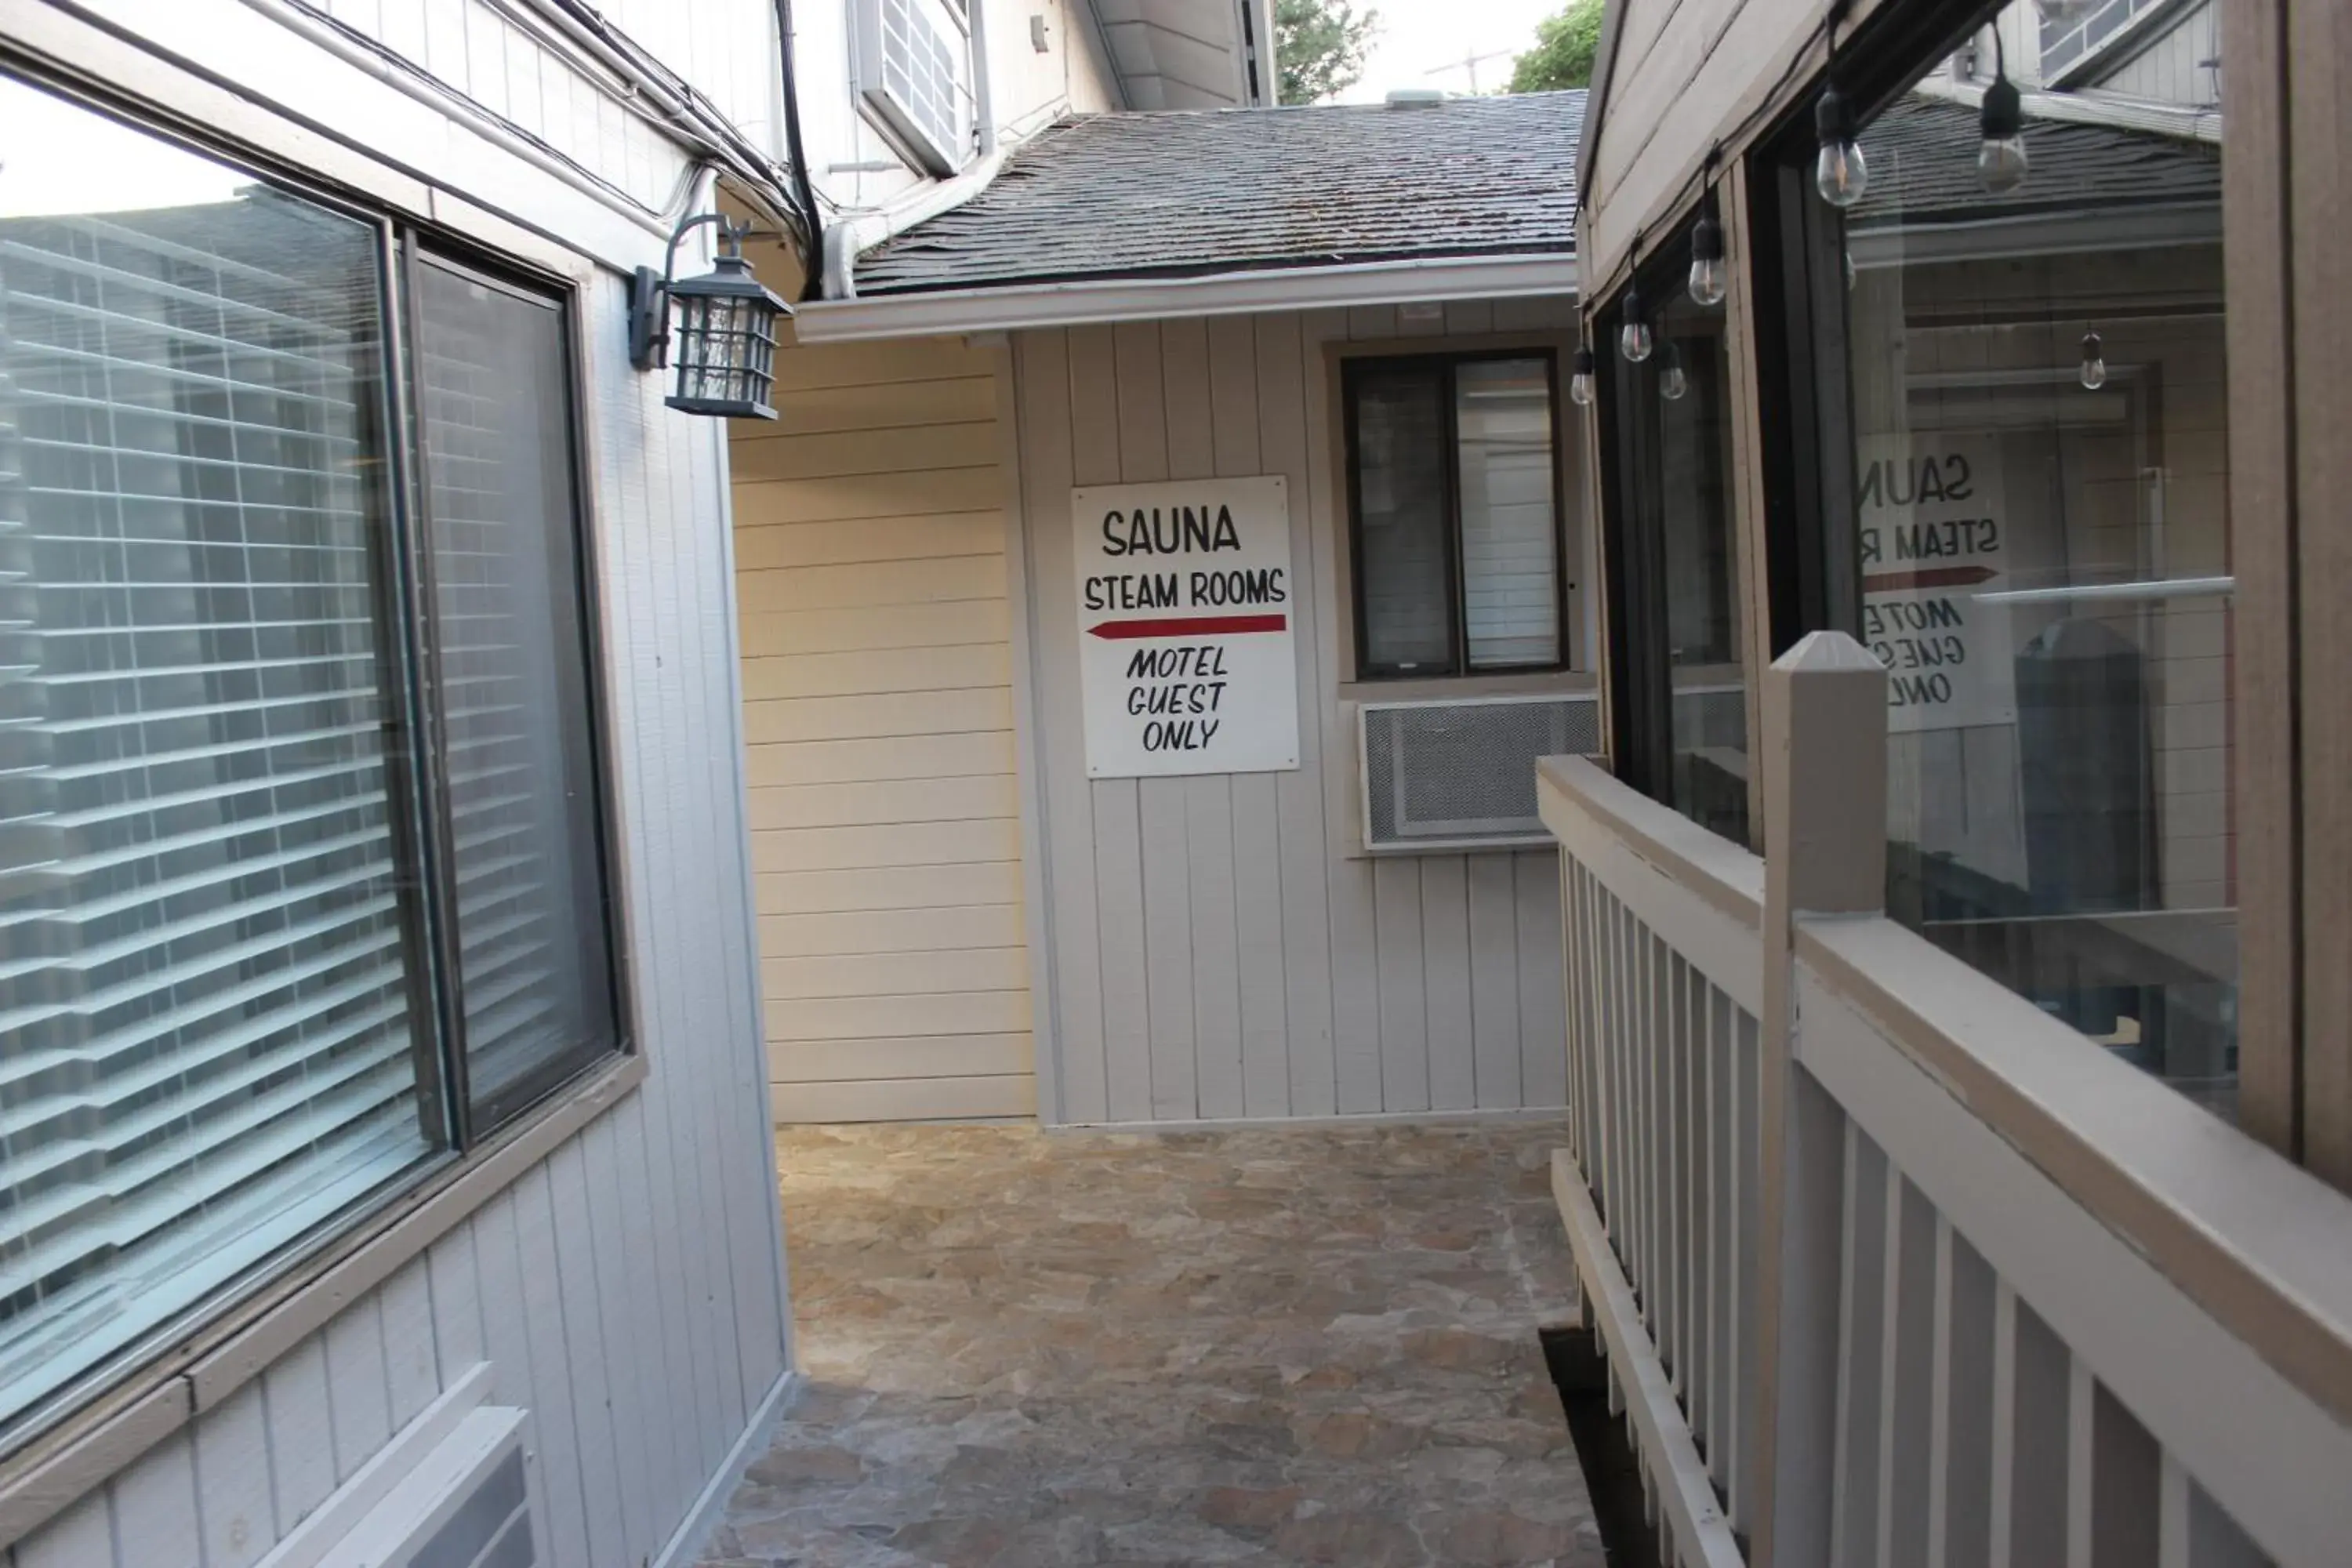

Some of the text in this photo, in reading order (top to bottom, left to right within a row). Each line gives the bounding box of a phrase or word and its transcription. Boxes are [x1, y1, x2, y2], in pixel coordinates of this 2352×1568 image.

[1102, 504, 1242, 556] SAUNA
[1084, 568, 1287, 611] STEAM ROOMS
[1127, 645, 1229, 678] MOTEL
[1127, 681, 1227, 716] GUEST
[1142, 719, 1220, 752] ONLY
